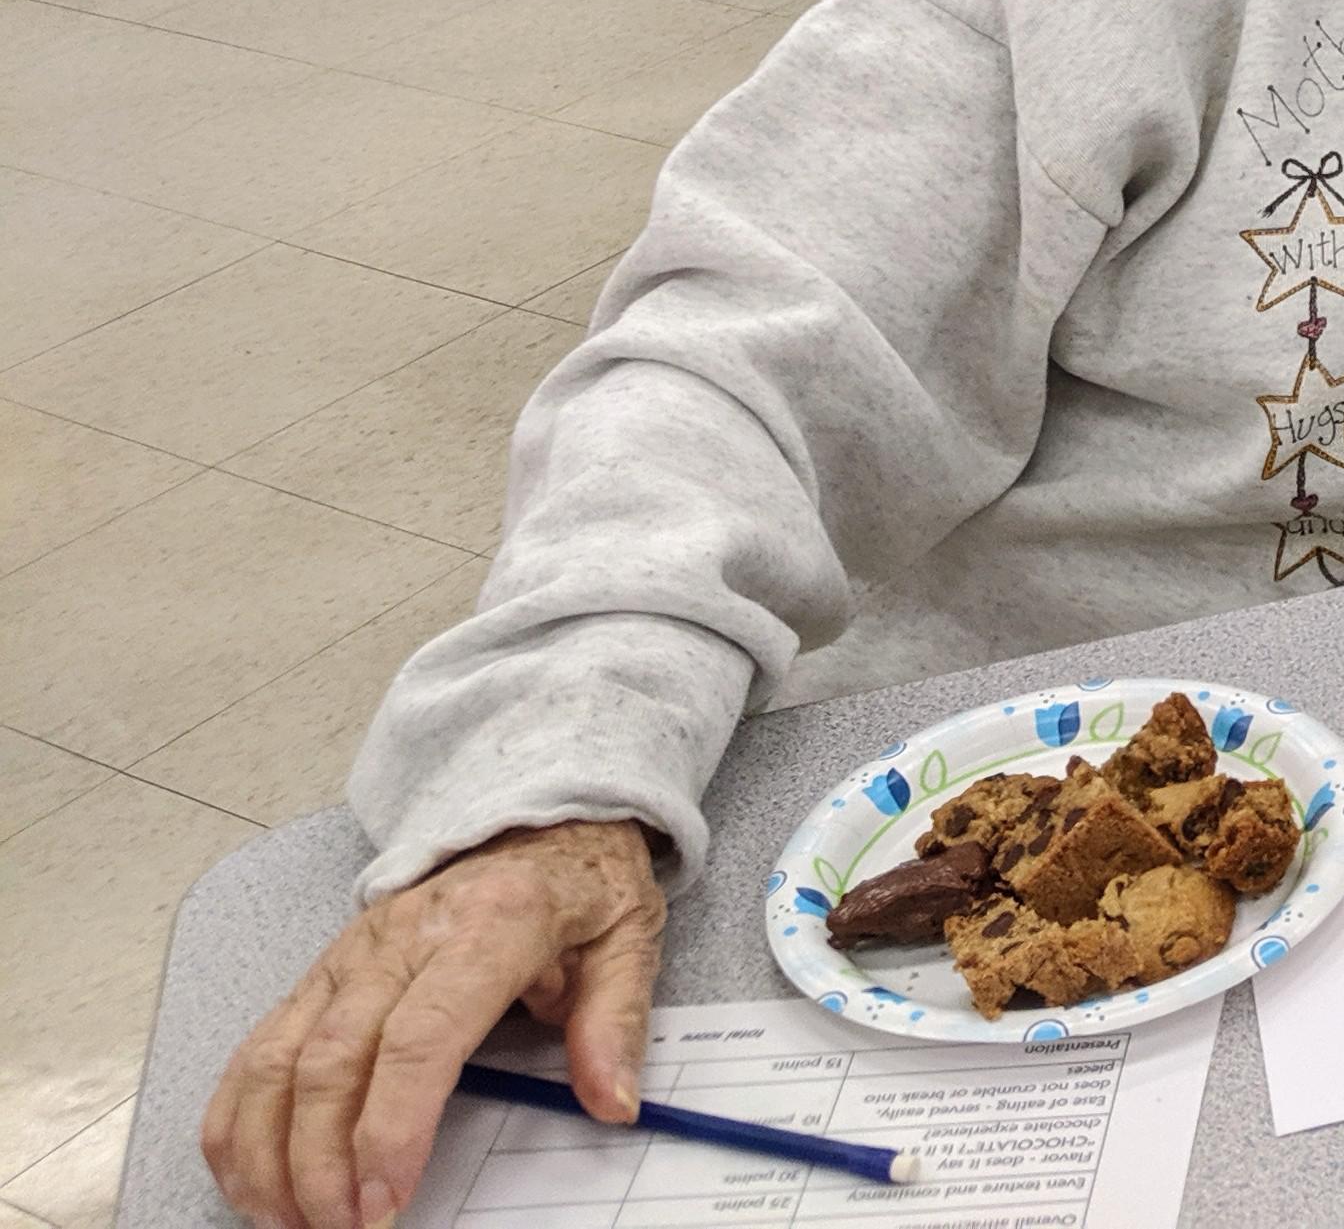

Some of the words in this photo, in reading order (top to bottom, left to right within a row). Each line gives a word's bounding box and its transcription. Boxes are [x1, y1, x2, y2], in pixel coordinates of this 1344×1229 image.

[1024, 1039, 1121, 1055] Presentation
[1066, 1058, 1118, 1075] pieces
[972, 1083, 1037, 1097] crumble
[1040, 1082, 1069, 1093] not
[1073, 1079, 1111, 1090] does
[863, 1092, 897, 1104] into
[901, 1090, 946, 1102] break
[949, 1088, 969, 1098] or
[995, 1098, 1046, 1112] eating
[1048, 1098, 1068, 1110] of
[1072, 1094, 1107, 1107] Ease
[927, 1103, 981, 1117] served
[922, 1119, 1021, 1141] experience?
[1022, 1118, 1102, 1132] chocolate
[936, 1157, 964, 1170] say
[968, 1157, 981, 1169] it
[985, 1155, 1025, 1168] does
[1040, 1150, 1093, 1164] Flavor
[981, 1179, 1041, 1194] texture
[1046, 1176, 1086, 1190] Even
[846, 1186, 941, 1202] consistency
[944, 1184, 978, 1198] and
